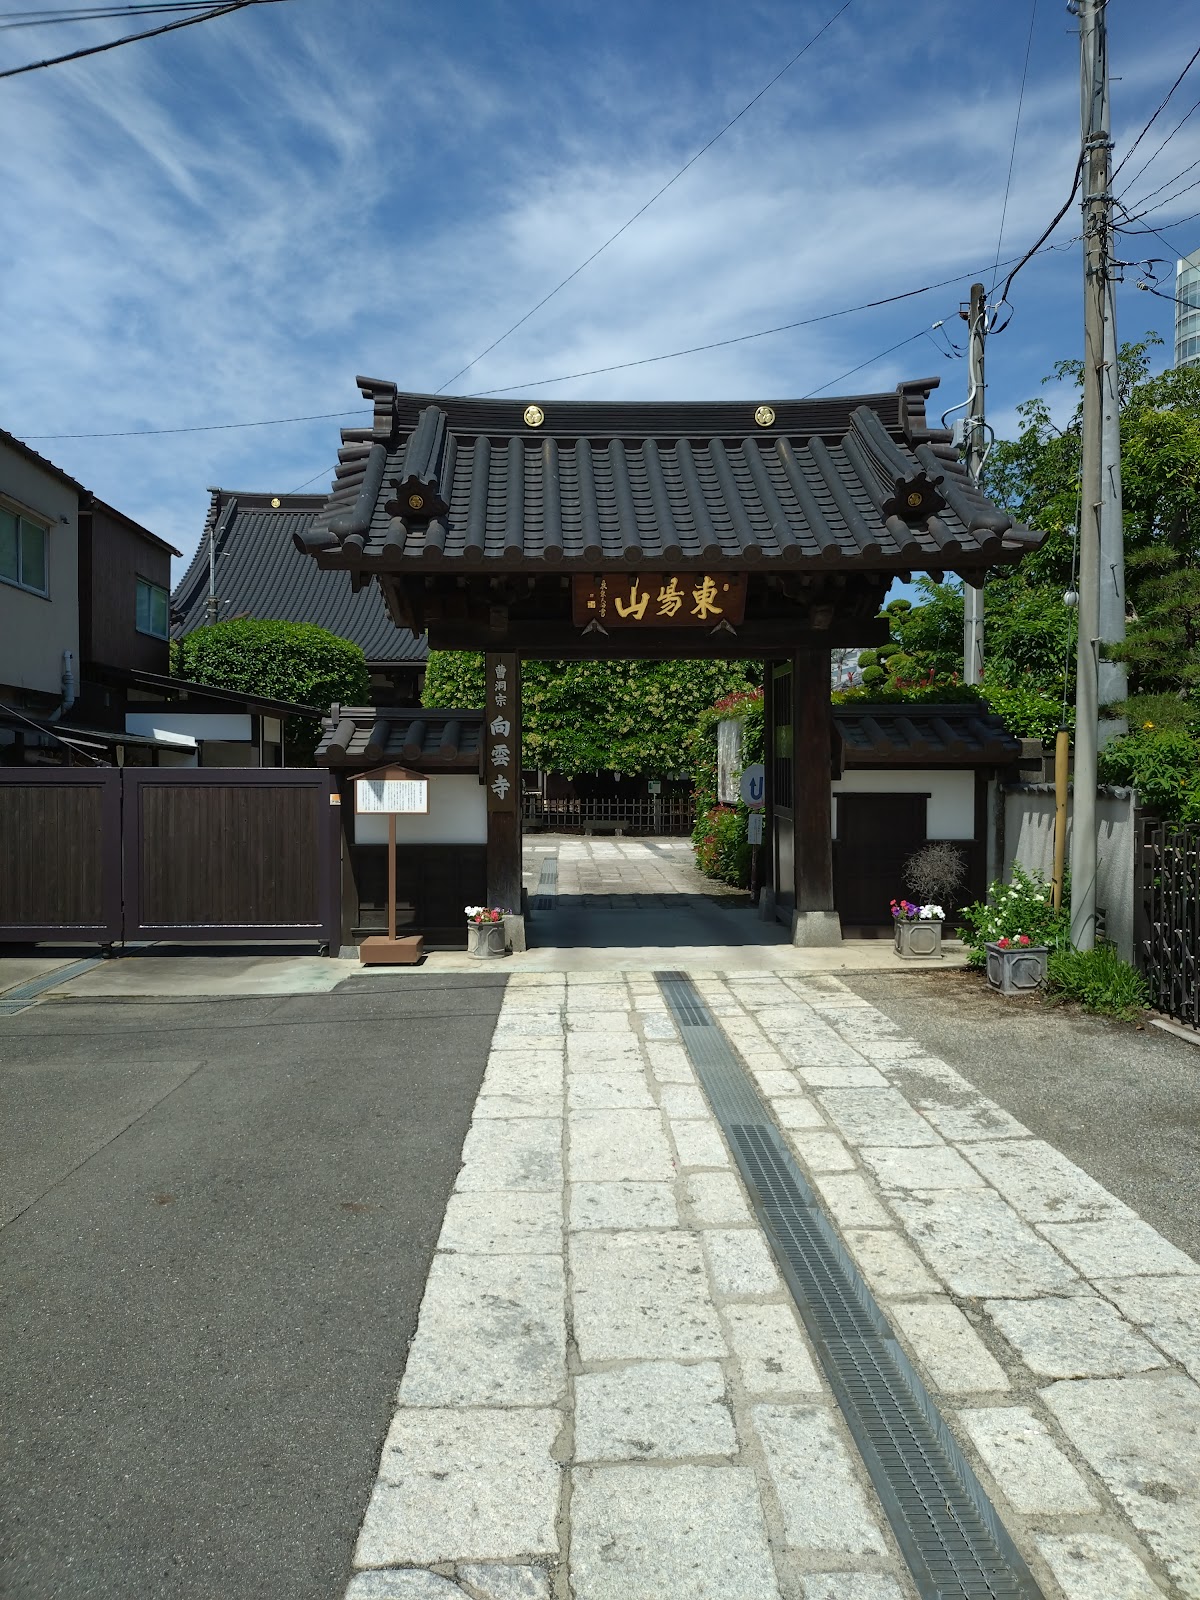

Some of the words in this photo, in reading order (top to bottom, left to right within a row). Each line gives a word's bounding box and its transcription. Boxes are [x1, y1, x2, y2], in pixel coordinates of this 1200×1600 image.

[494, 664, 507, 708] 曹洞宗
[489, 715, 511, 800] 向雲寺
